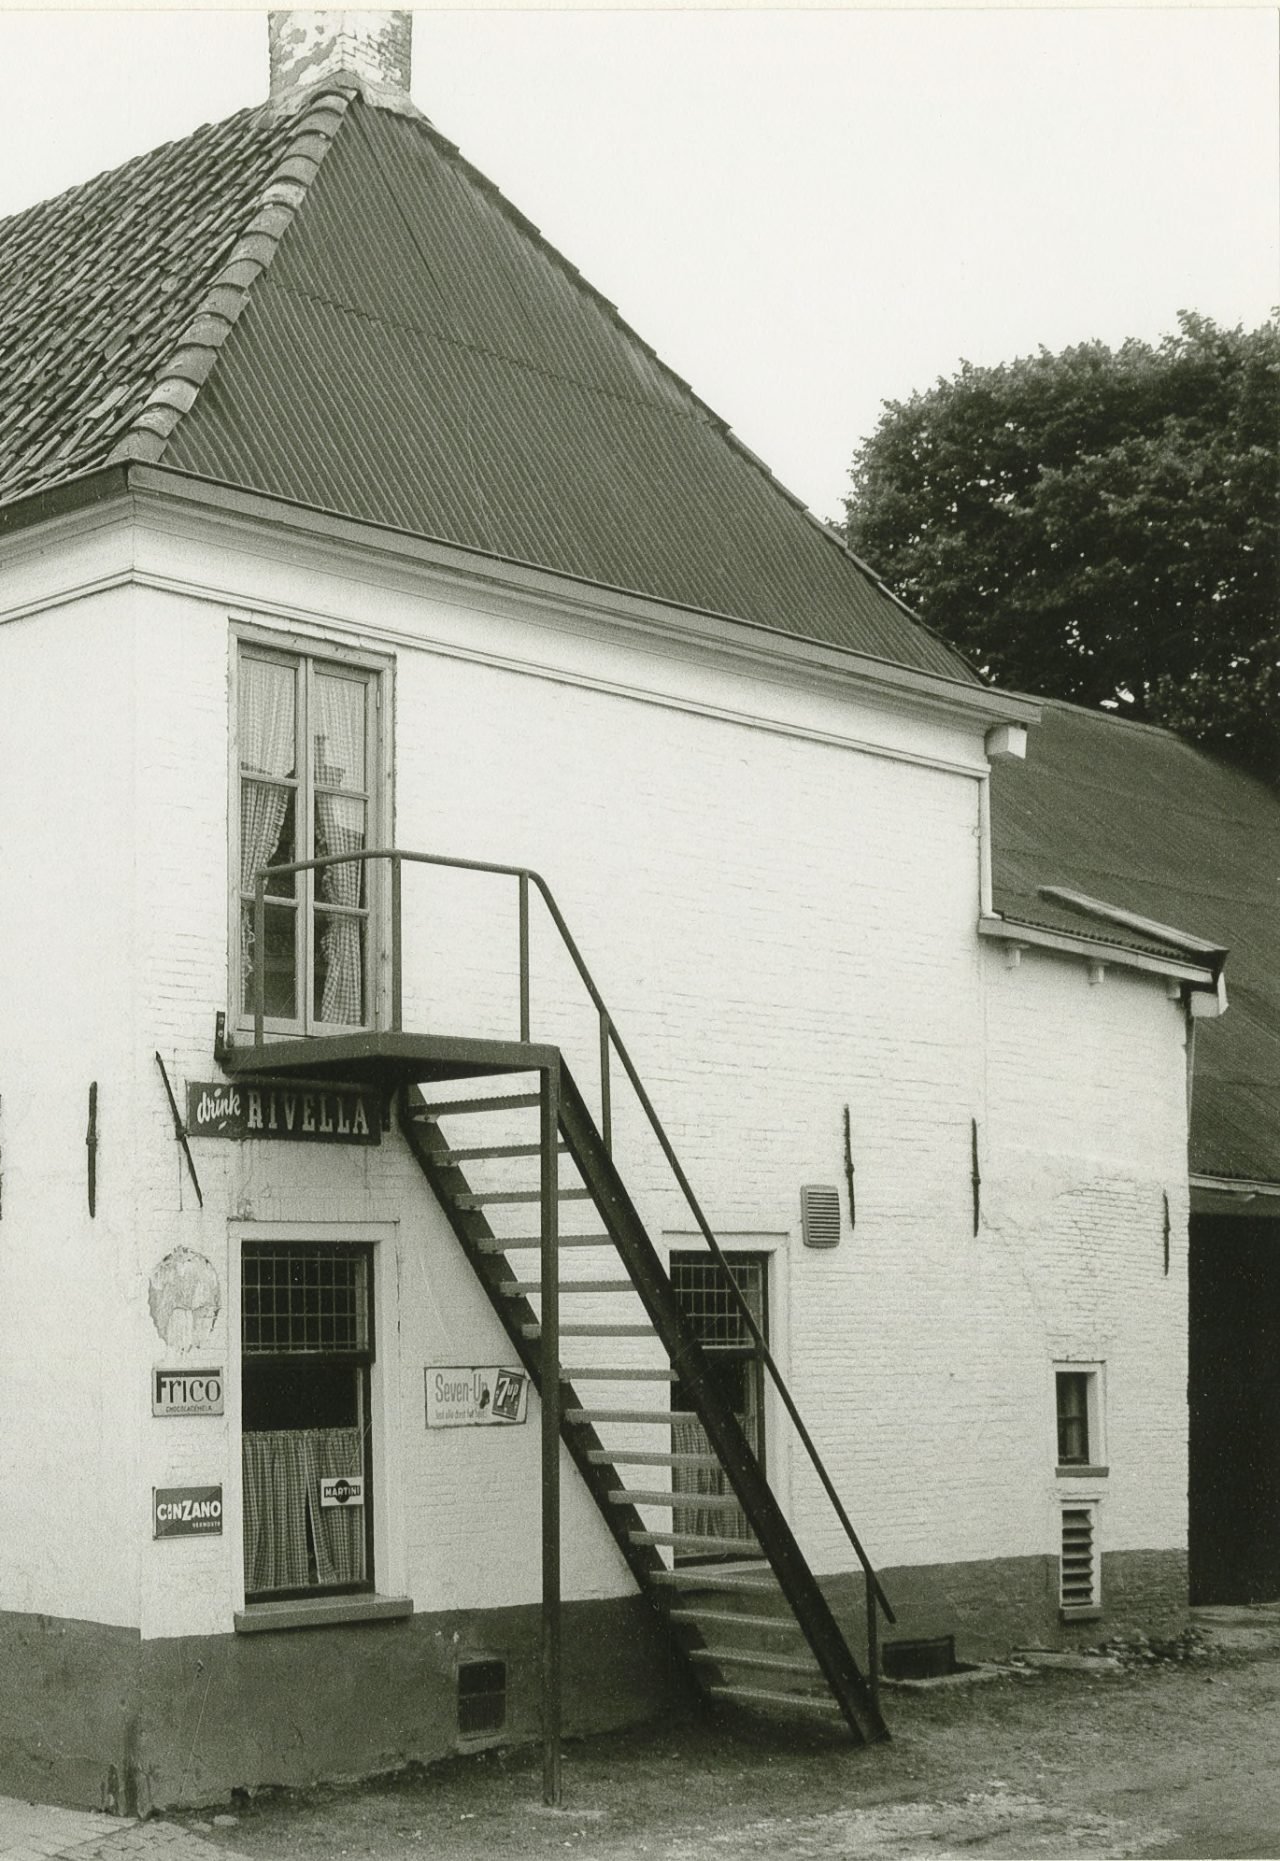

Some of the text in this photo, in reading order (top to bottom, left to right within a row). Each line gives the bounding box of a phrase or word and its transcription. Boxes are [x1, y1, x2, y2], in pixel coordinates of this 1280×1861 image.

[197, 1088, 370, 1135] drink RIVELLA
[324, 1485, 361, 1498] MARTINI
[156, 1500, 222, 1521] CINZANO
